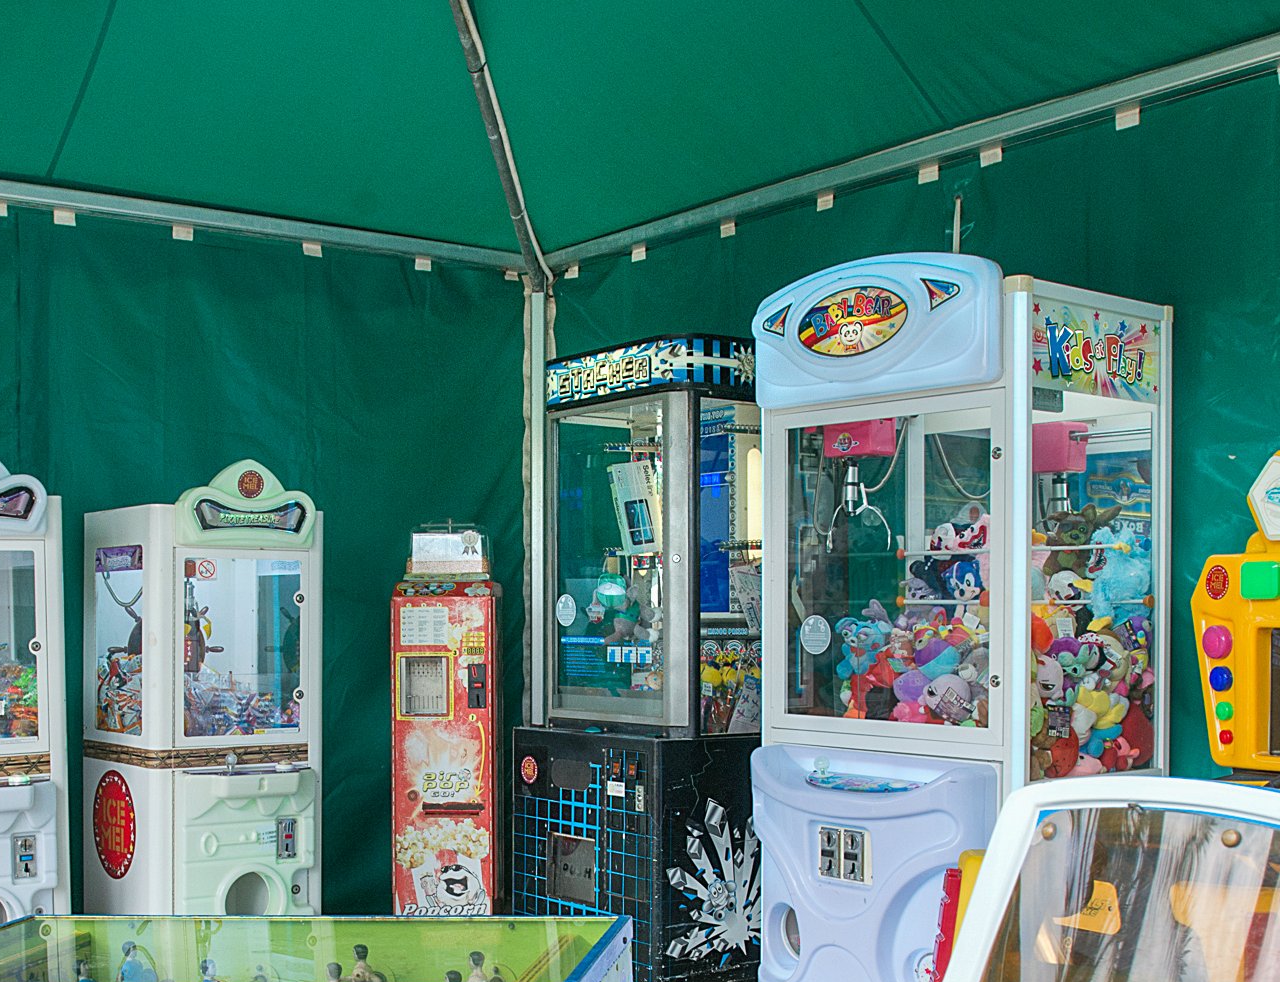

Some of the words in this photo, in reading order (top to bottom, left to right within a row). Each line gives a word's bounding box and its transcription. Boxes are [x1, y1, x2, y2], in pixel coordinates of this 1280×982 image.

[811, 298, 848, 337] BABY
[853, 292, 892, 317] BEAR
[1046, 322, 1094, 377] Kids
[1105, 334, 1145, 384] Play!
[557, 354, 650, 397] STACKER
[220, 513, 245, 524] PIRATE
[422, 770, 458, 781] air
[422, 778, 470, 793] pop
[102, 798, 126, 826] ICE
[101, 824, 128, 854] MEL
[402, 903, 487, 916] Popcorn
